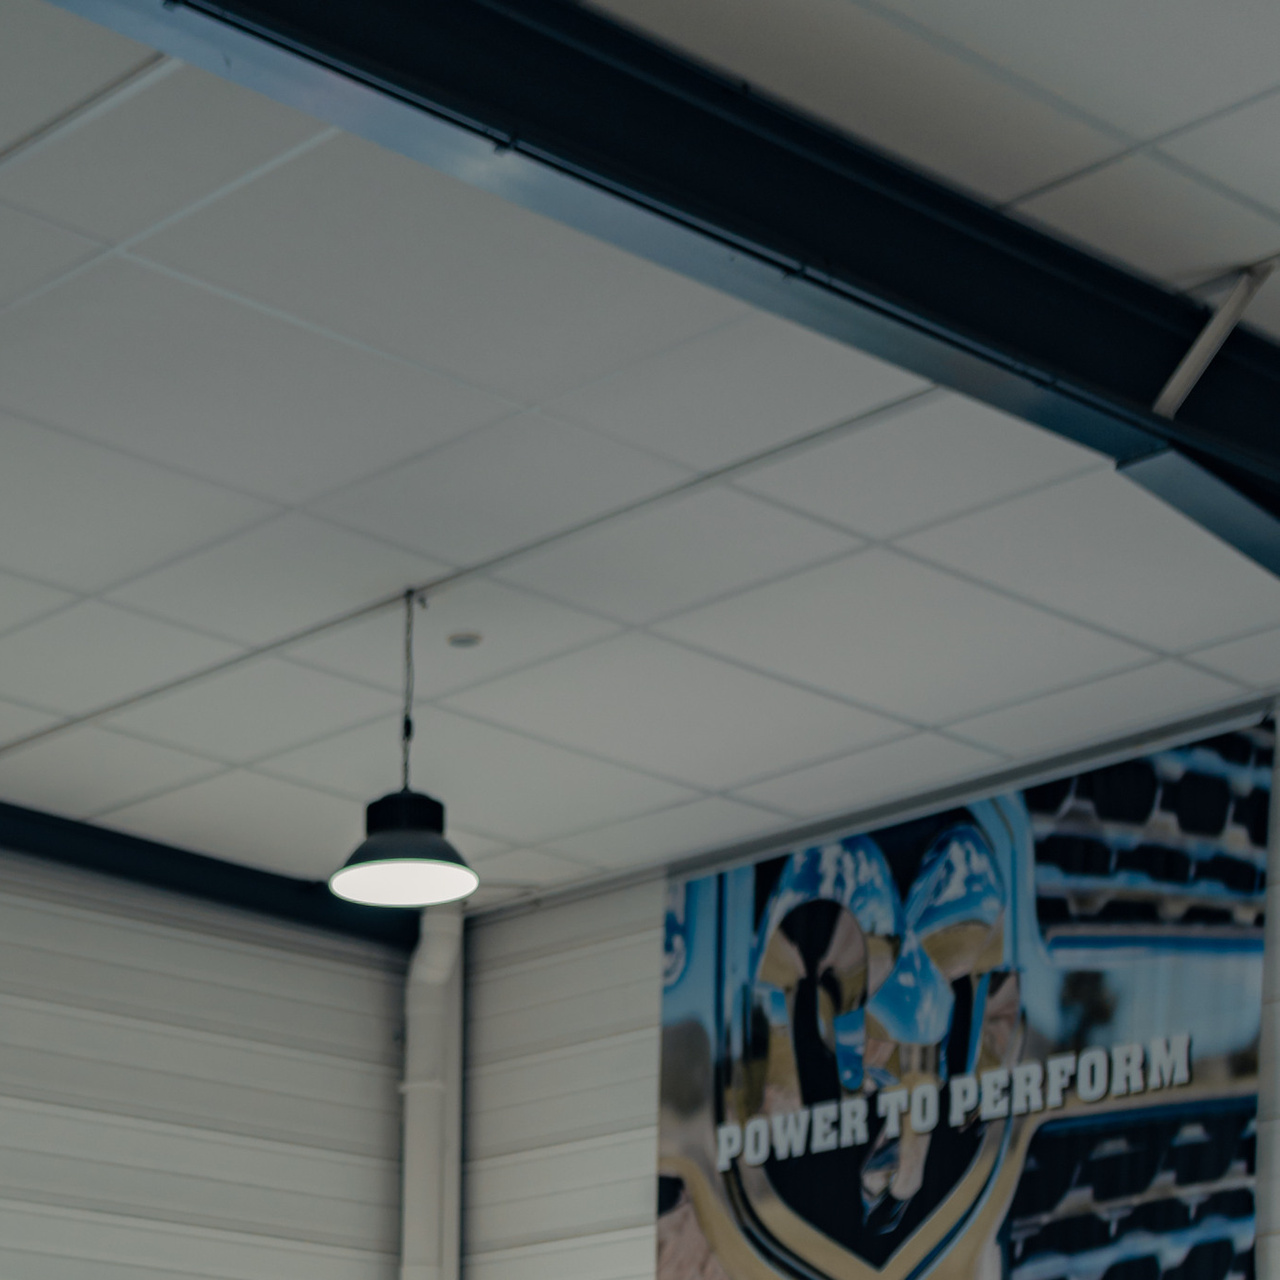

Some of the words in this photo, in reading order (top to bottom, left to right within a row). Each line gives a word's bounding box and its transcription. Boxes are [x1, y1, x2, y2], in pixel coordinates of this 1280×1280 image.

[717, 1098, 870, 1171] POWER
[877, 1082, 940, 1138] TO
[950, 1034, 1192, 1127] PERFORM
